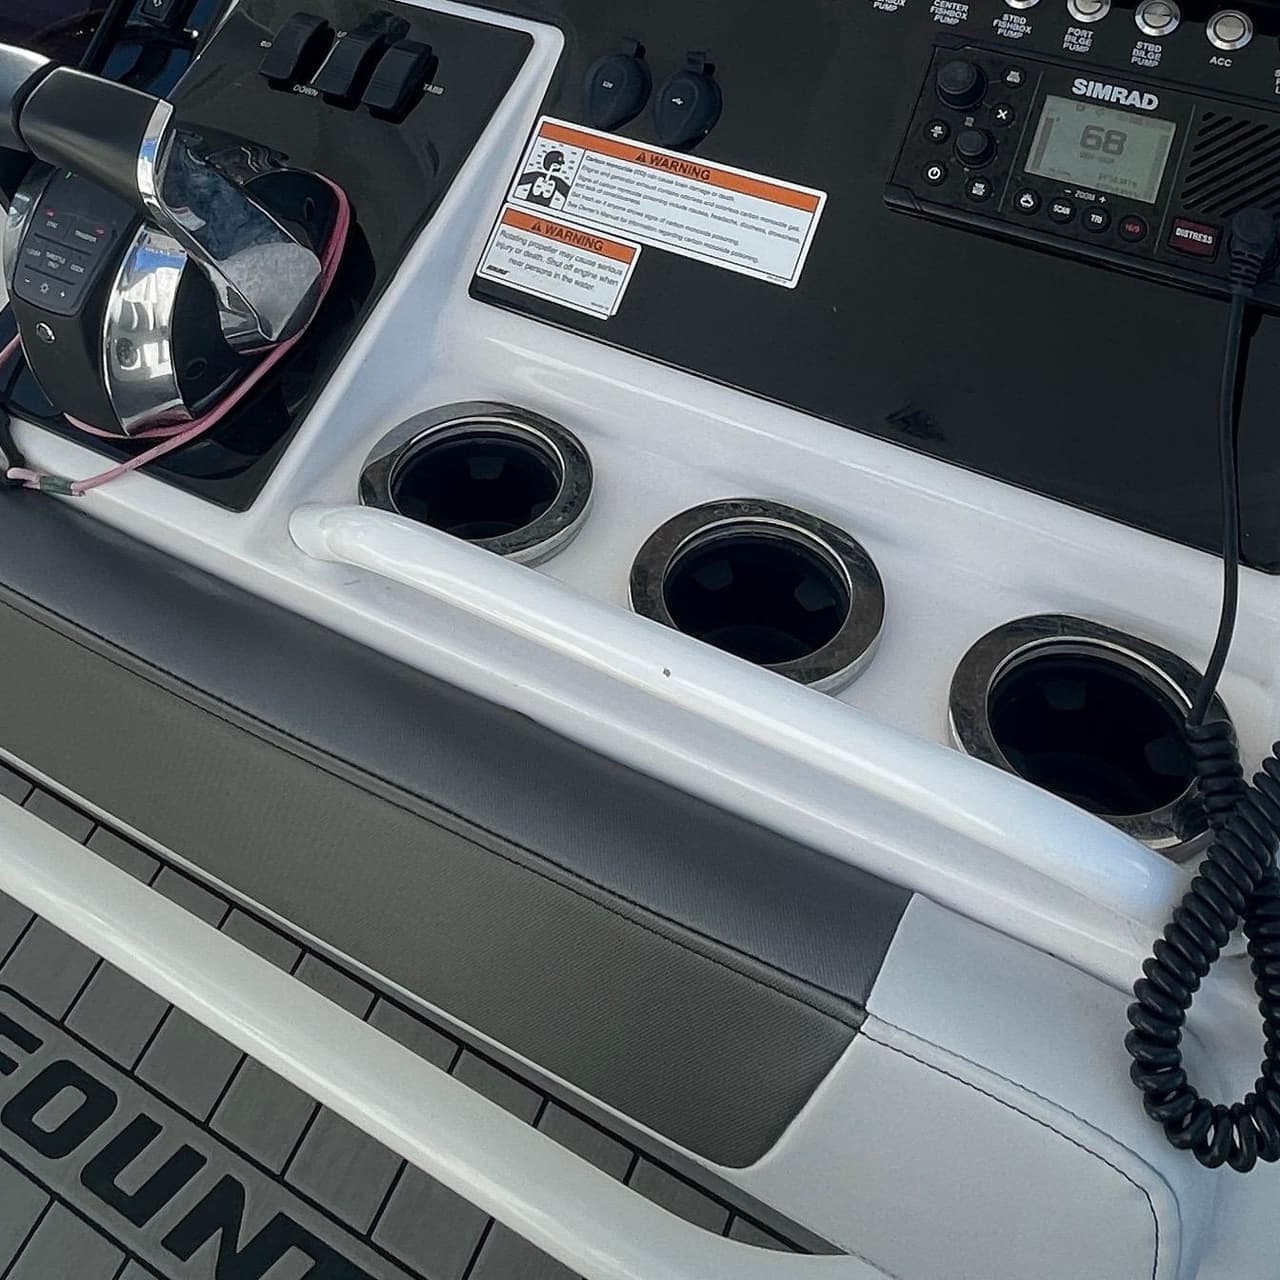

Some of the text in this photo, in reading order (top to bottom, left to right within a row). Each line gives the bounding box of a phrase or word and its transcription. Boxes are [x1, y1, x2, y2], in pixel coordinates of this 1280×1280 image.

[873, 1, 898, 12] PUMP
[929, 6, 968, 20] FISHBOX
[933, 0, 969, 13] CENTER
[934, 14, 960, 25] PUMP
[1002, 14, 1027, 25] STBD
[992, 19, 1033, 34] FISHBOX
[1068, 27, 1094, 38] PORT
[997, 28, 1024, 39] PUMP
[1064, 34, 1093, 47] BILGE
[1135, 41, 1162, 53] STBD
[1063, 42, 1090, 53] PUMP
[1132, 48, 1162, 62] BILGE
[1209, 56, 1233, 67] ACC
[1130, 56, 1159, 68] PUMP
[293, 84, 320, 97] DOWN
[1072, 78, 1159, 111] SIMRAD
[1079, 124, 1128, 156] 68
[648, 155, 710, 181] WARNING
[1052, 204, 1071, 215] SCAN
[545, 223, 604, 252] WARNING
[1175, 227, 1213, 245] DISTRESS
